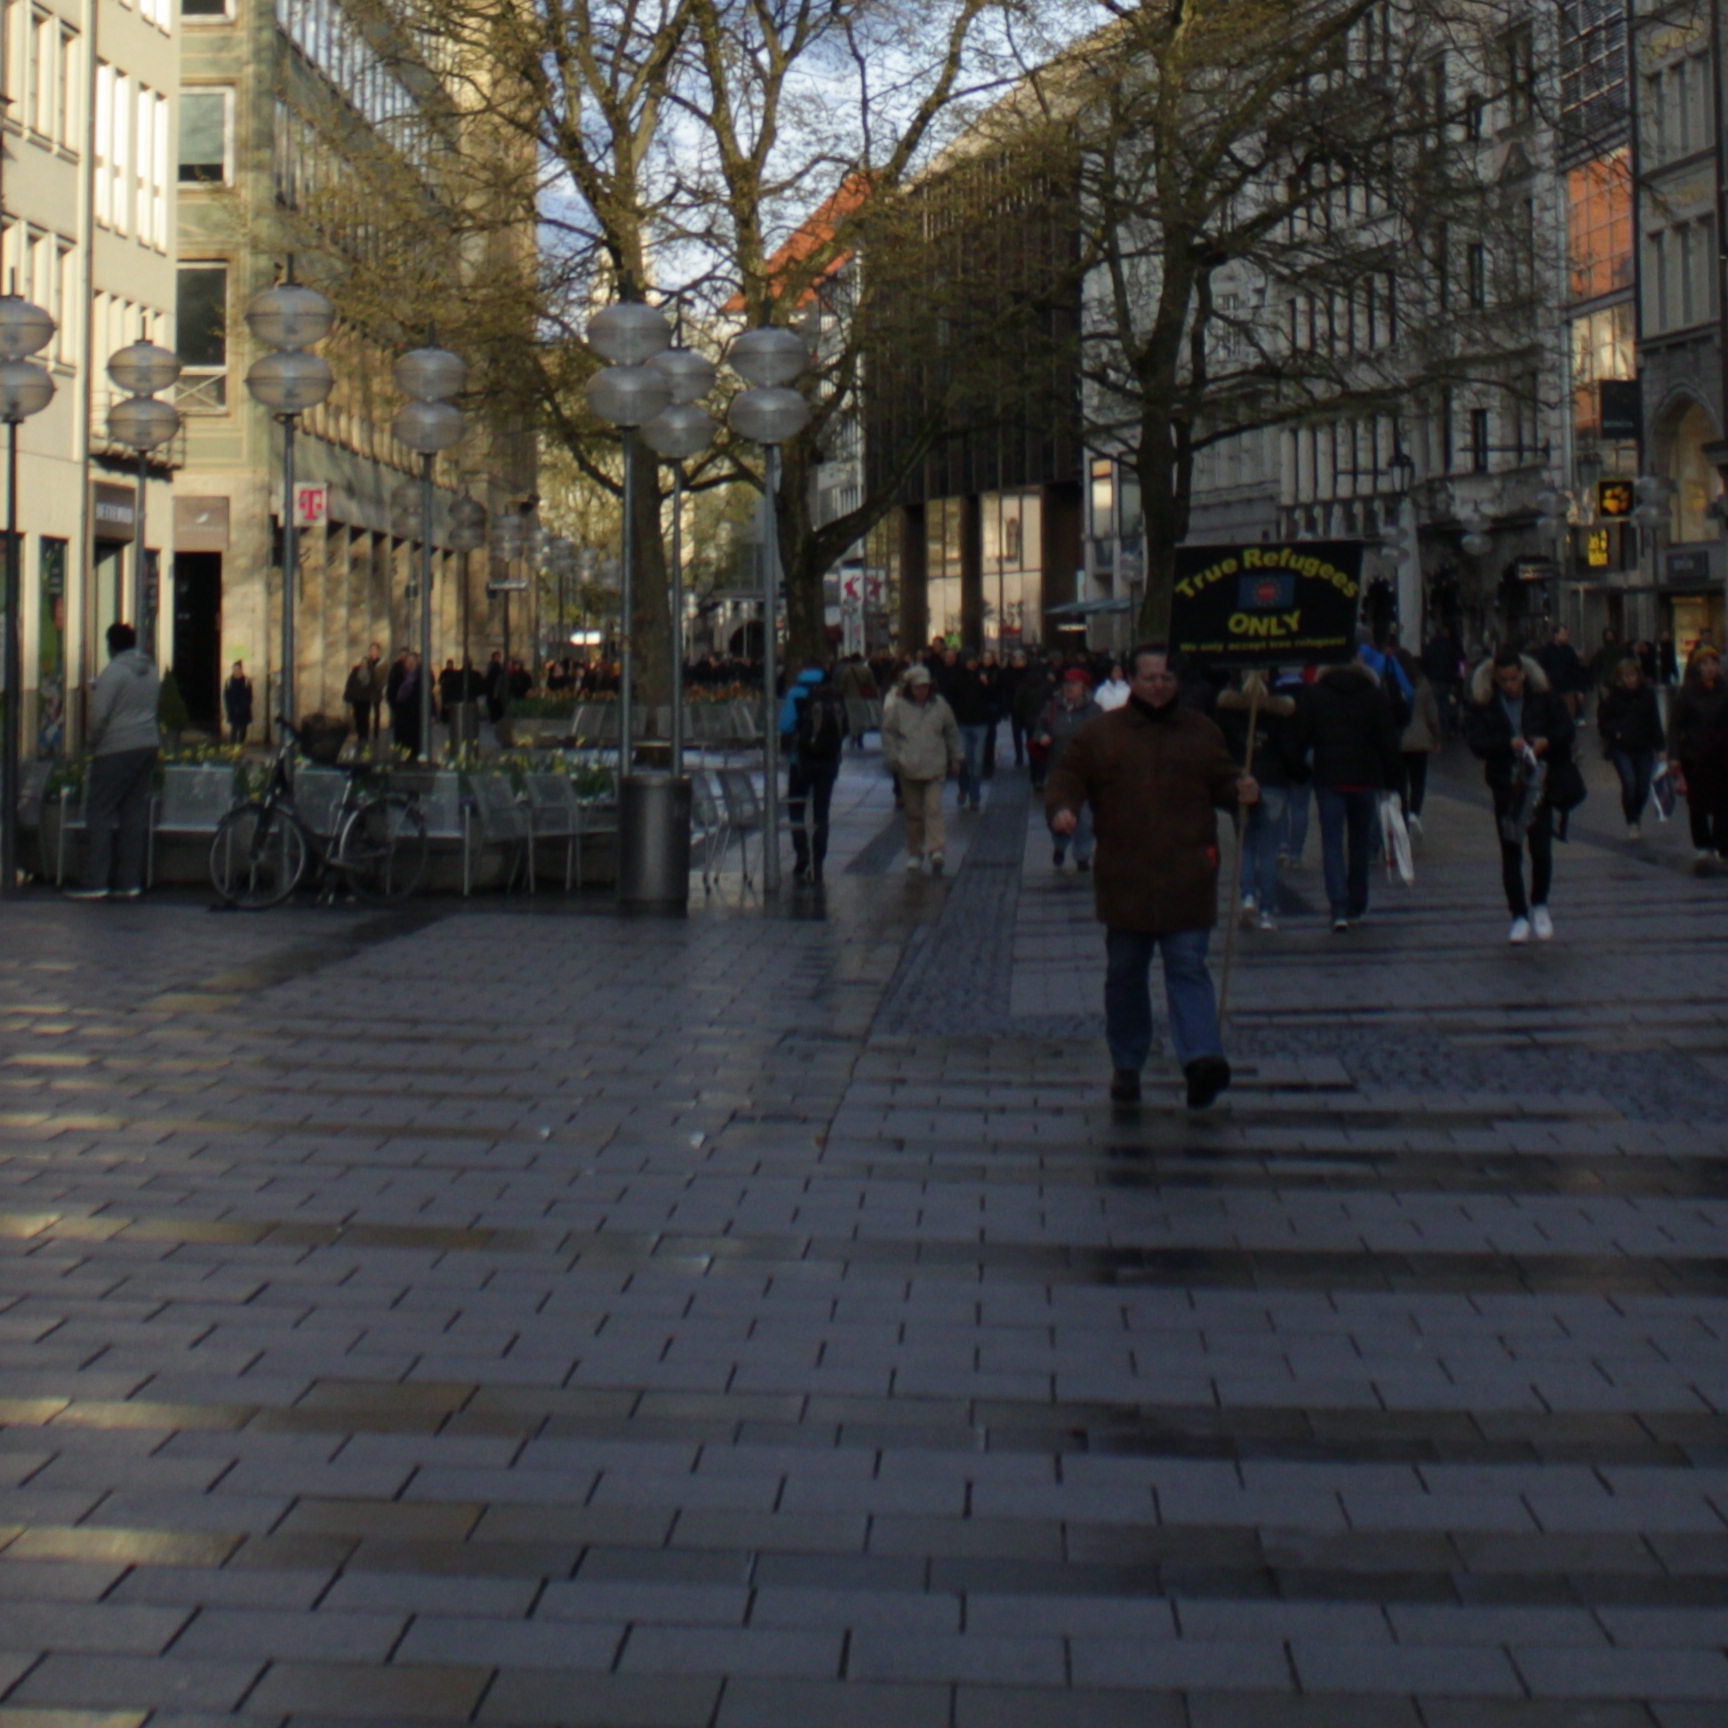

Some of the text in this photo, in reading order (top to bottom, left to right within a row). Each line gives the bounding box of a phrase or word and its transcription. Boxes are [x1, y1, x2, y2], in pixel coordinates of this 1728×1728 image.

[1174, 547, 1359, 599] True Refugees
[1227, 608, 1303, 637] ONLY
